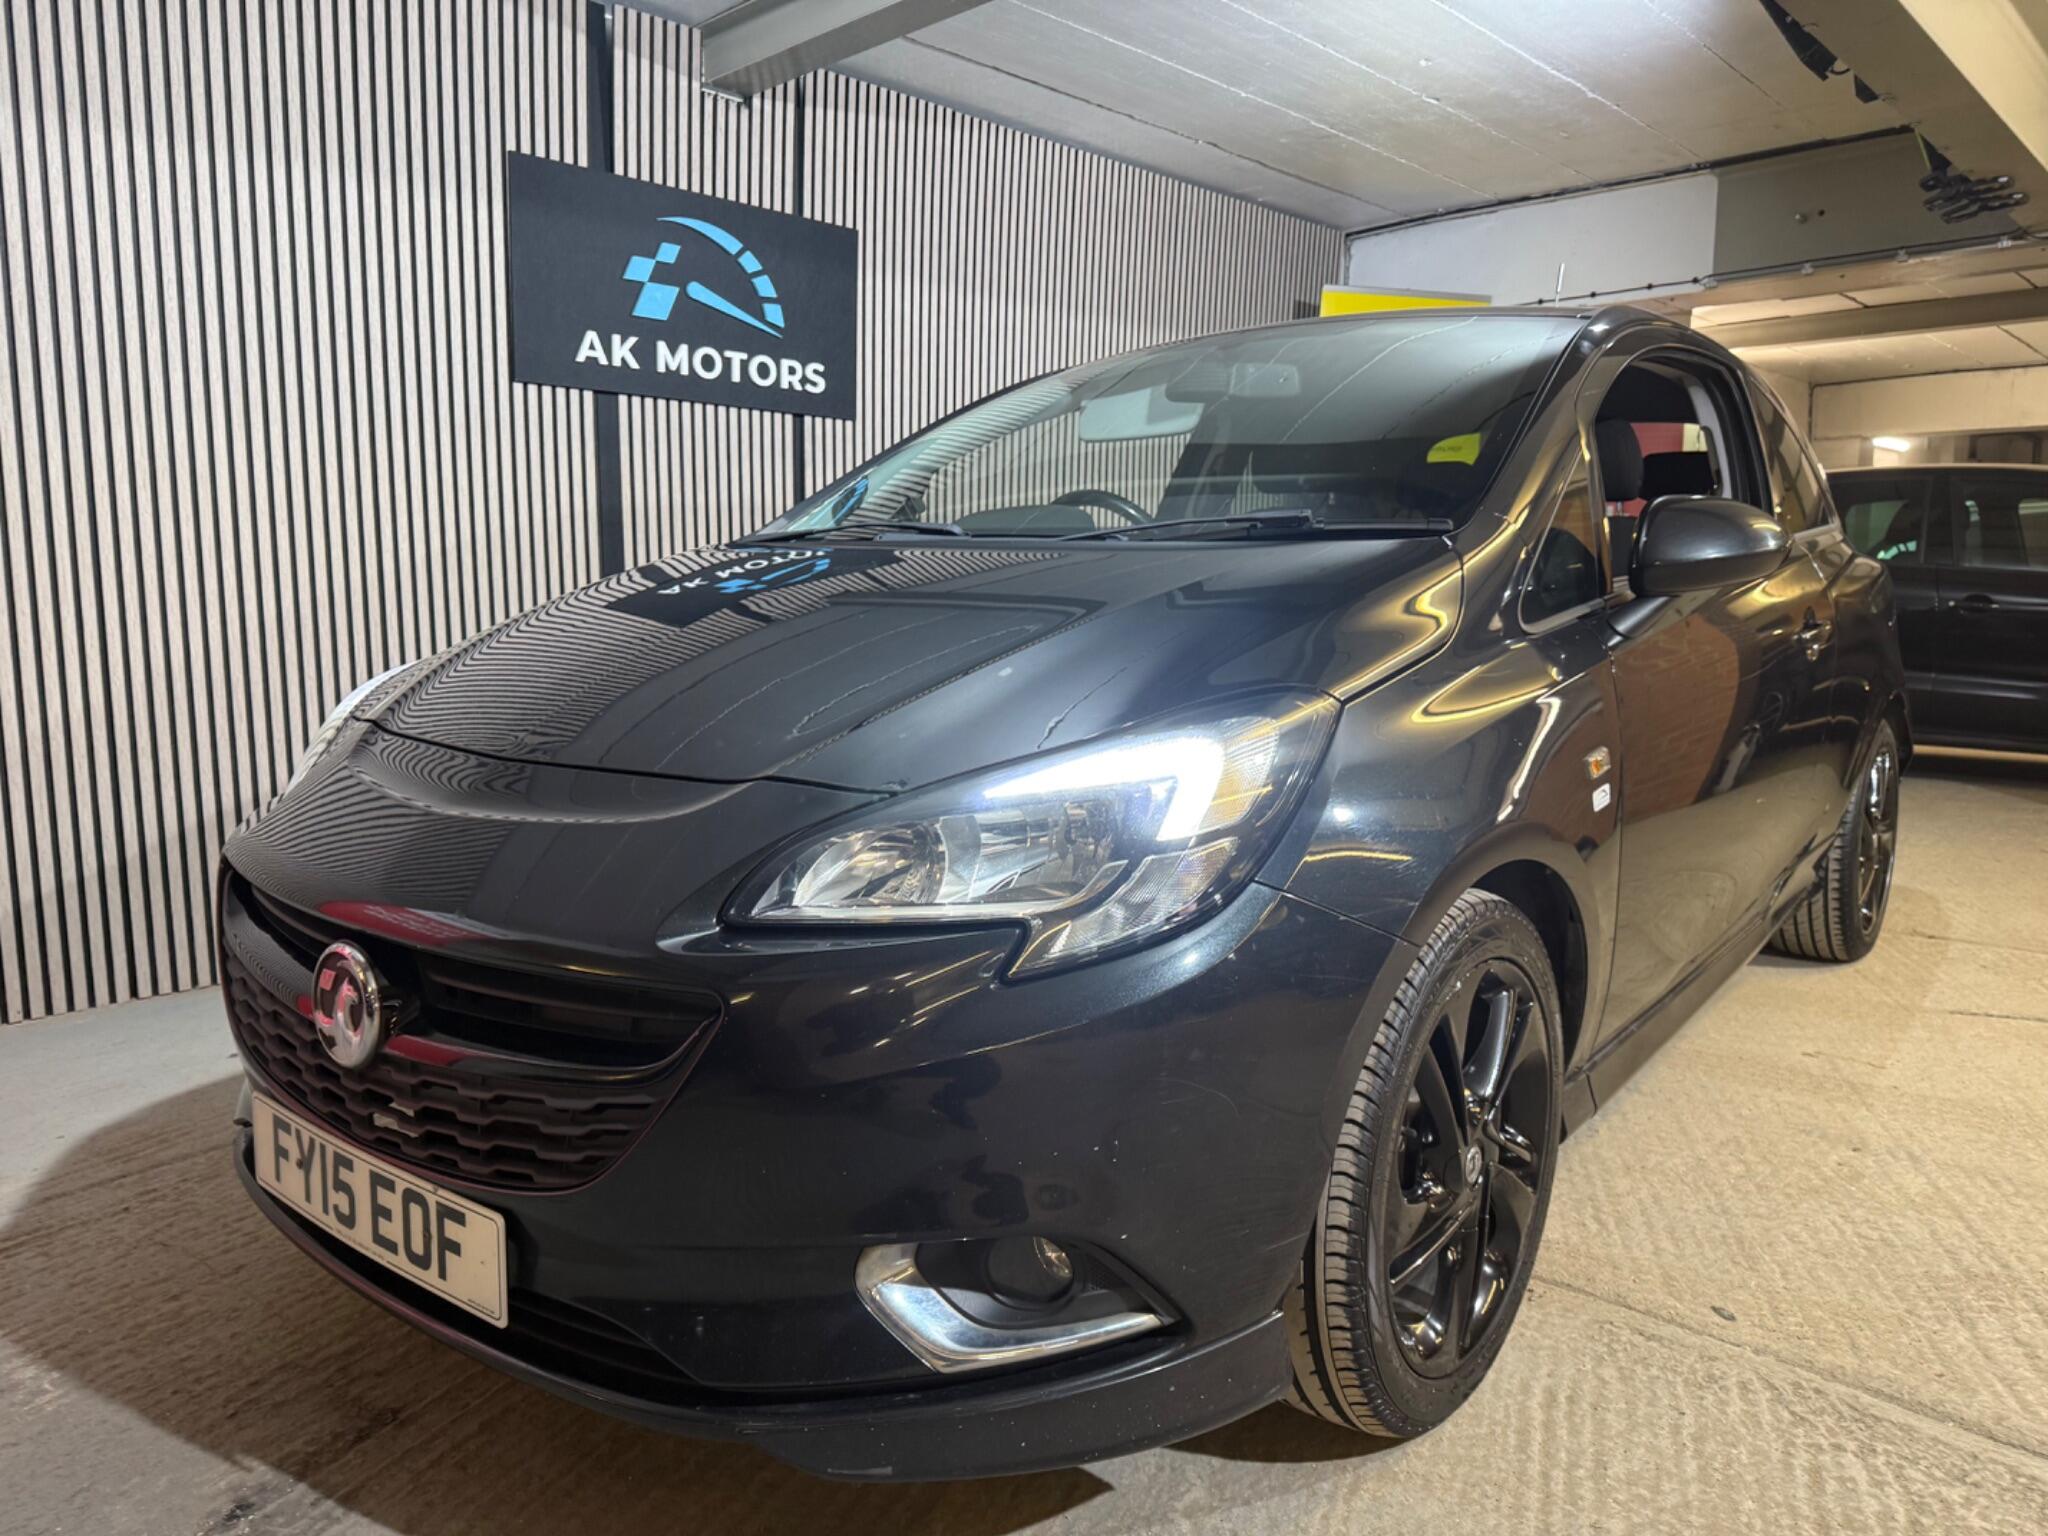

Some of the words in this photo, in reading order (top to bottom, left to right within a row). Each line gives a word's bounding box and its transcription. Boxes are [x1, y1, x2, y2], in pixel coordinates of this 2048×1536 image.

[574, 330, 641, 370] AK
[656, 340, 827, 394] MOTORS
[272, 1113, 356, 1230] FY15
[369, 1169, 466, 1282] EOF
